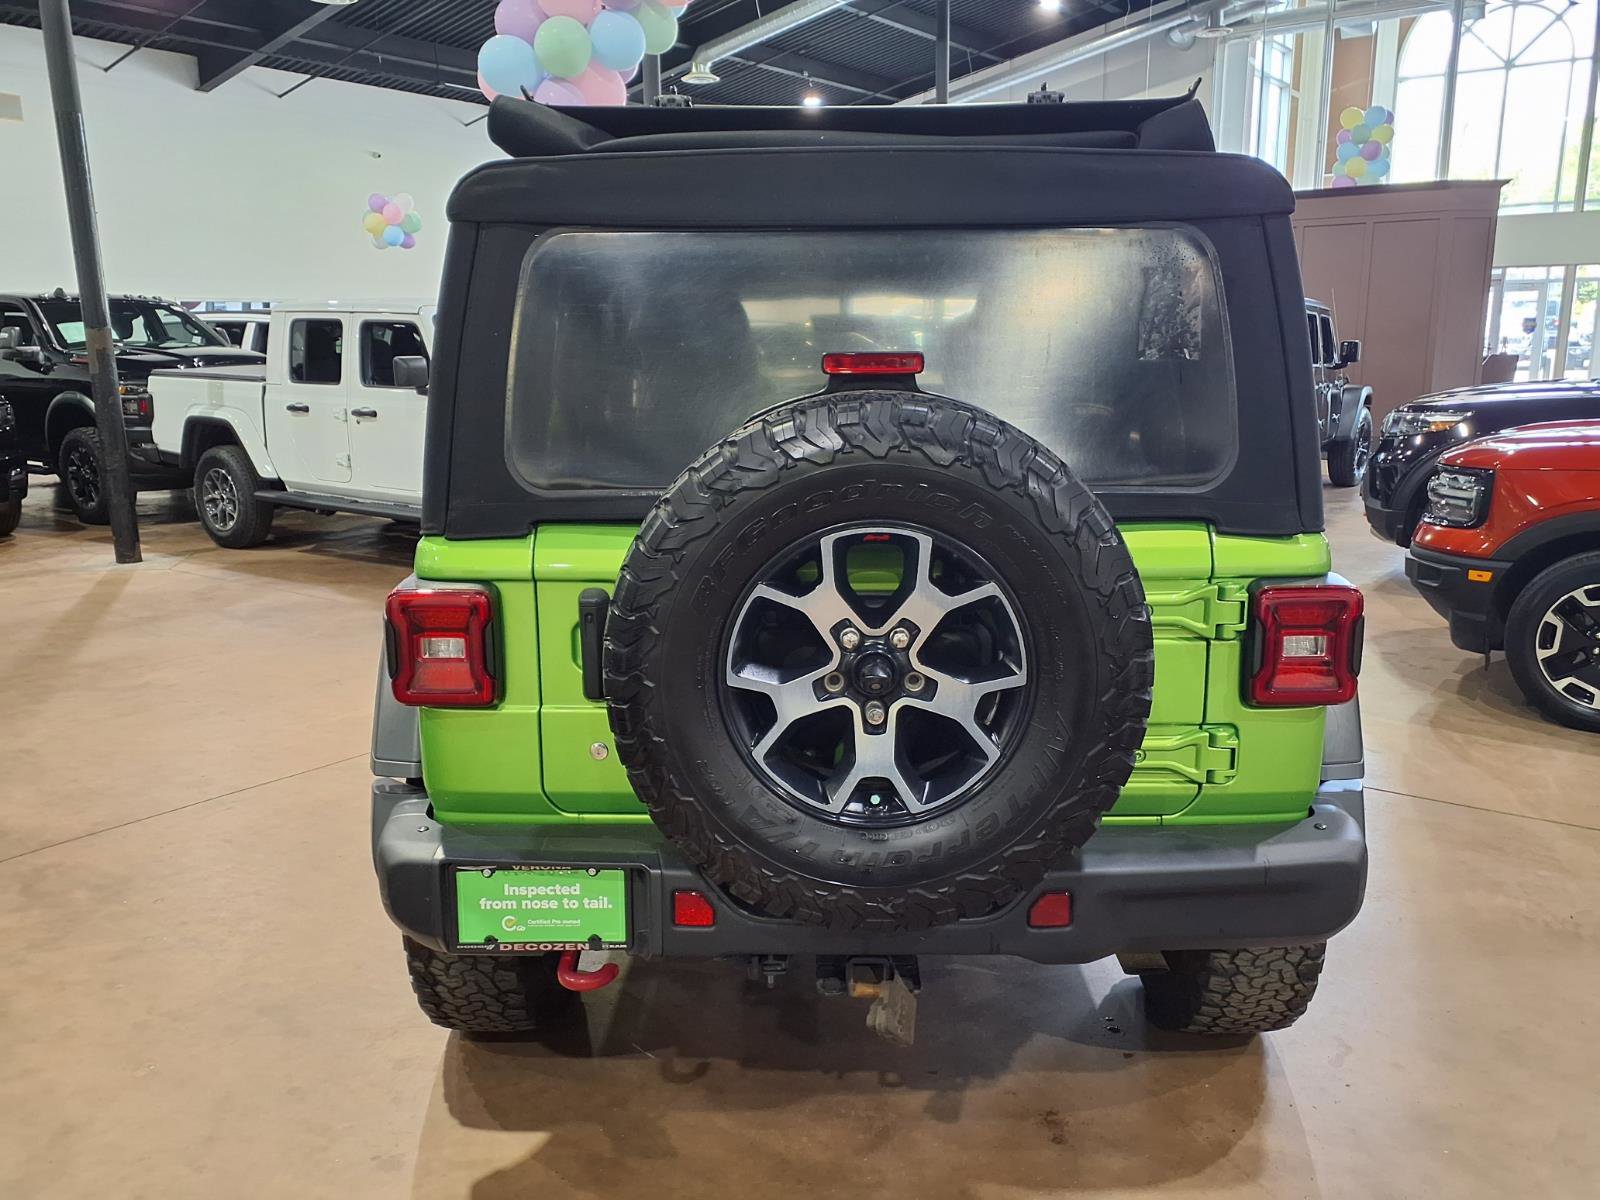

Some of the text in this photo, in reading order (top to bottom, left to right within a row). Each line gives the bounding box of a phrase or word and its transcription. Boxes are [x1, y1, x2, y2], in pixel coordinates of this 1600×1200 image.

[503, 883, 580, 898] Inspected
[479, 896, 613, 910] from nose to tail.
[499, 943, 590, 951] DECOZEN
